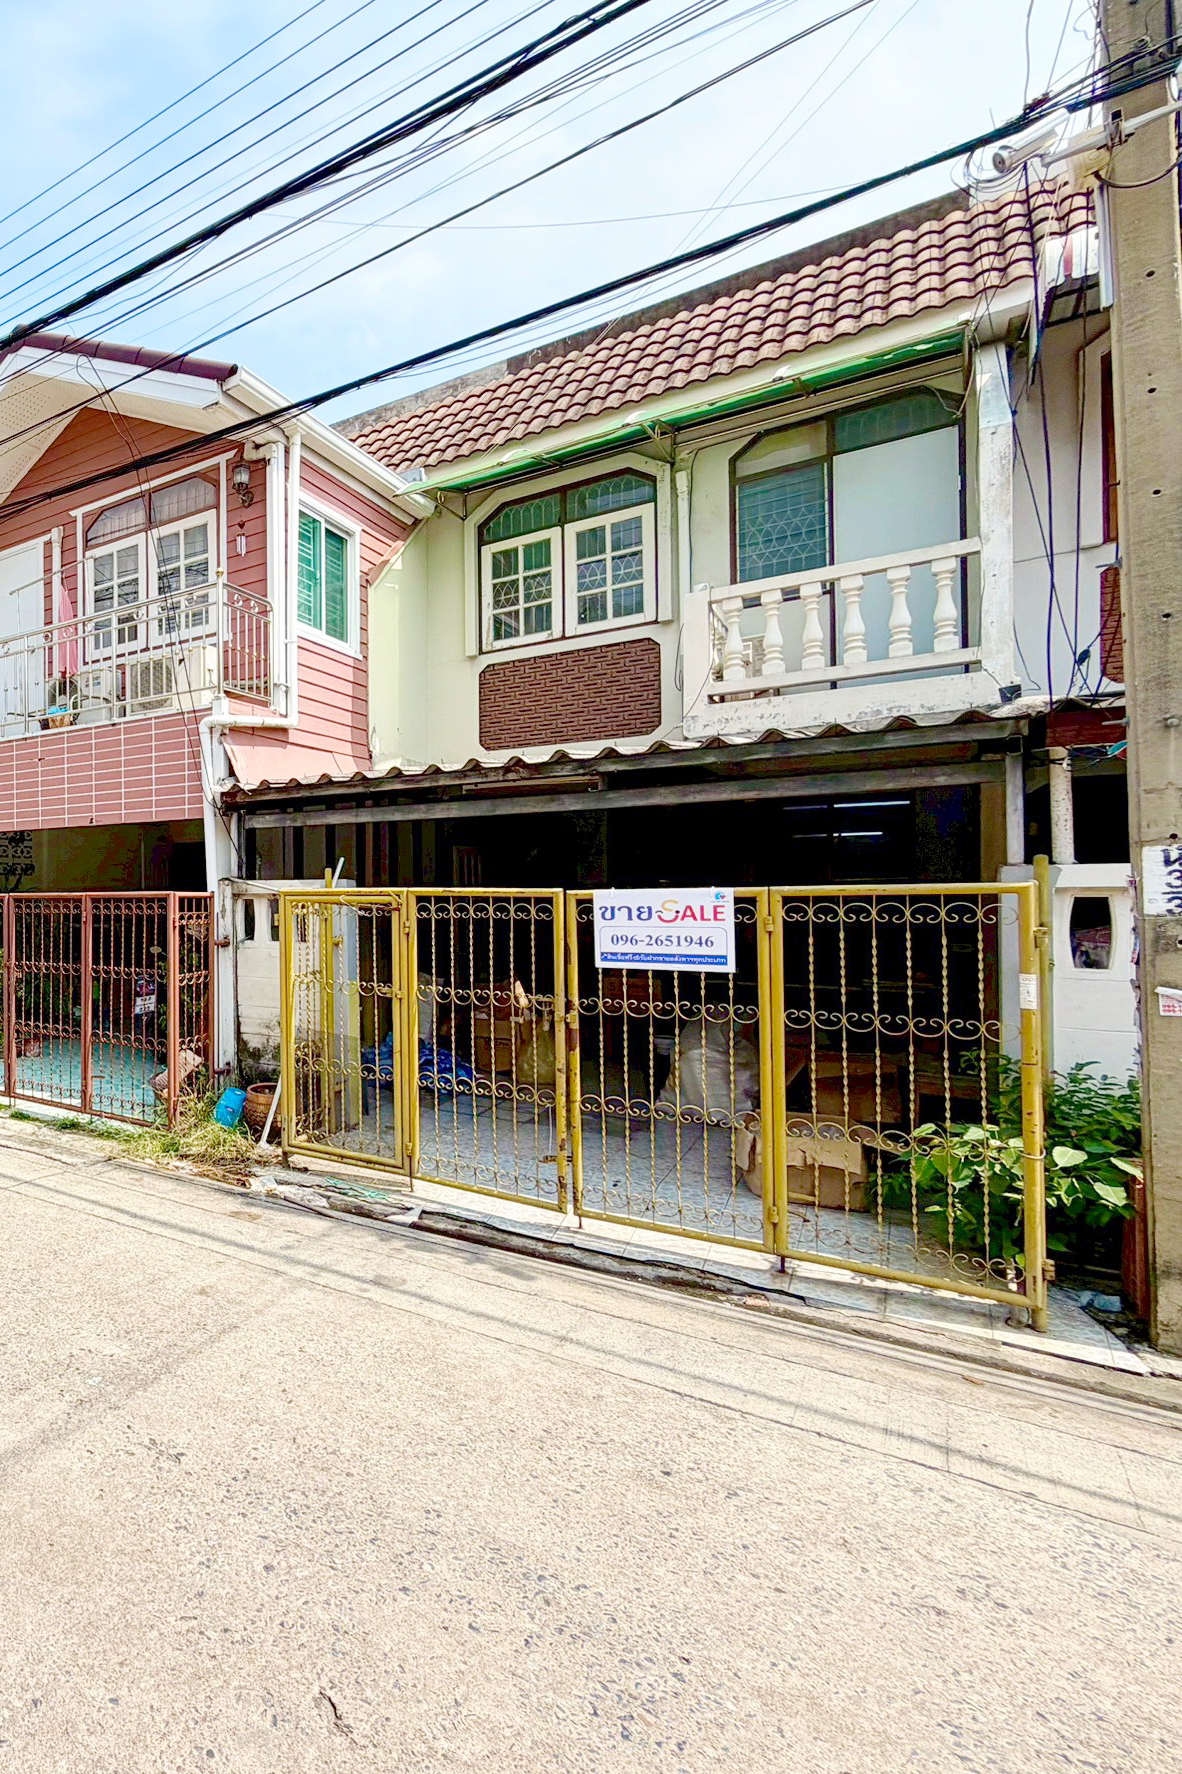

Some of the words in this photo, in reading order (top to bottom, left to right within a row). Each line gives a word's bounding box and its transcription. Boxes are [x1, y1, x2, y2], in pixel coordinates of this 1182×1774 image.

[599, 905, 653, 921] ขาย
[656, 899, 726, 923] SALE
[610, 934, 715, 948] 096-2651946
